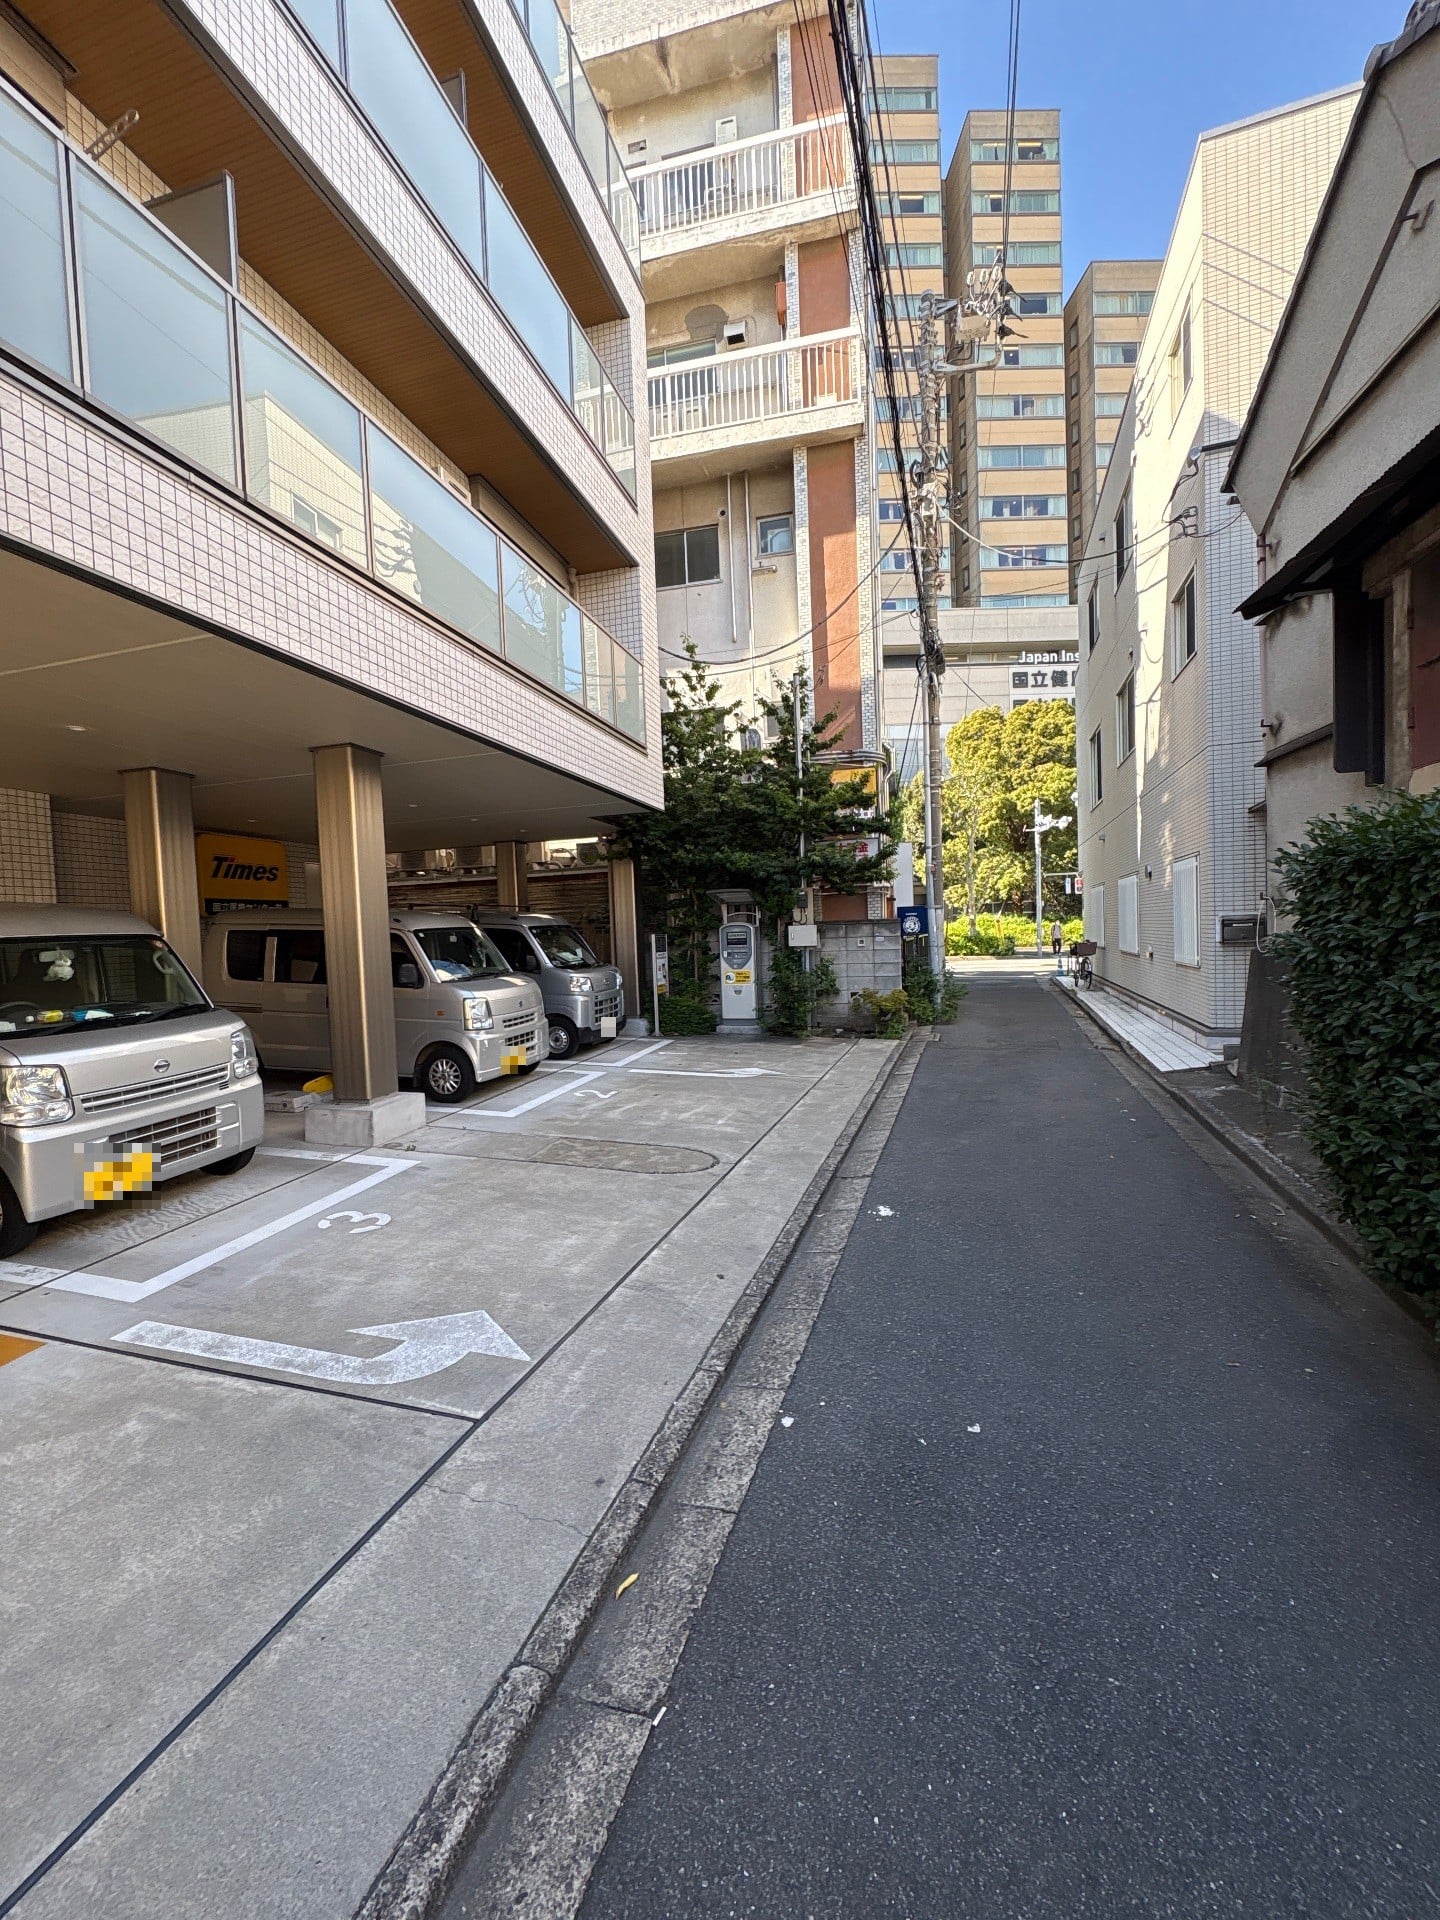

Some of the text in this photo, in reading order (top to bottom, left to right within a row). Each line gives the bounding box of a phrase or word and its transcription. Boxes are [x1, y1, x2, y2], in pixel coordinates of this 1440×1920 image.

[1018, 651, 1057, 664] Japan
[1013, 670, 1076, 688] 国立健
[211, 856, 279, 881] Times
[574, 1089, 618, 1098] 2
[318, 1211, 392, 1234] 3
